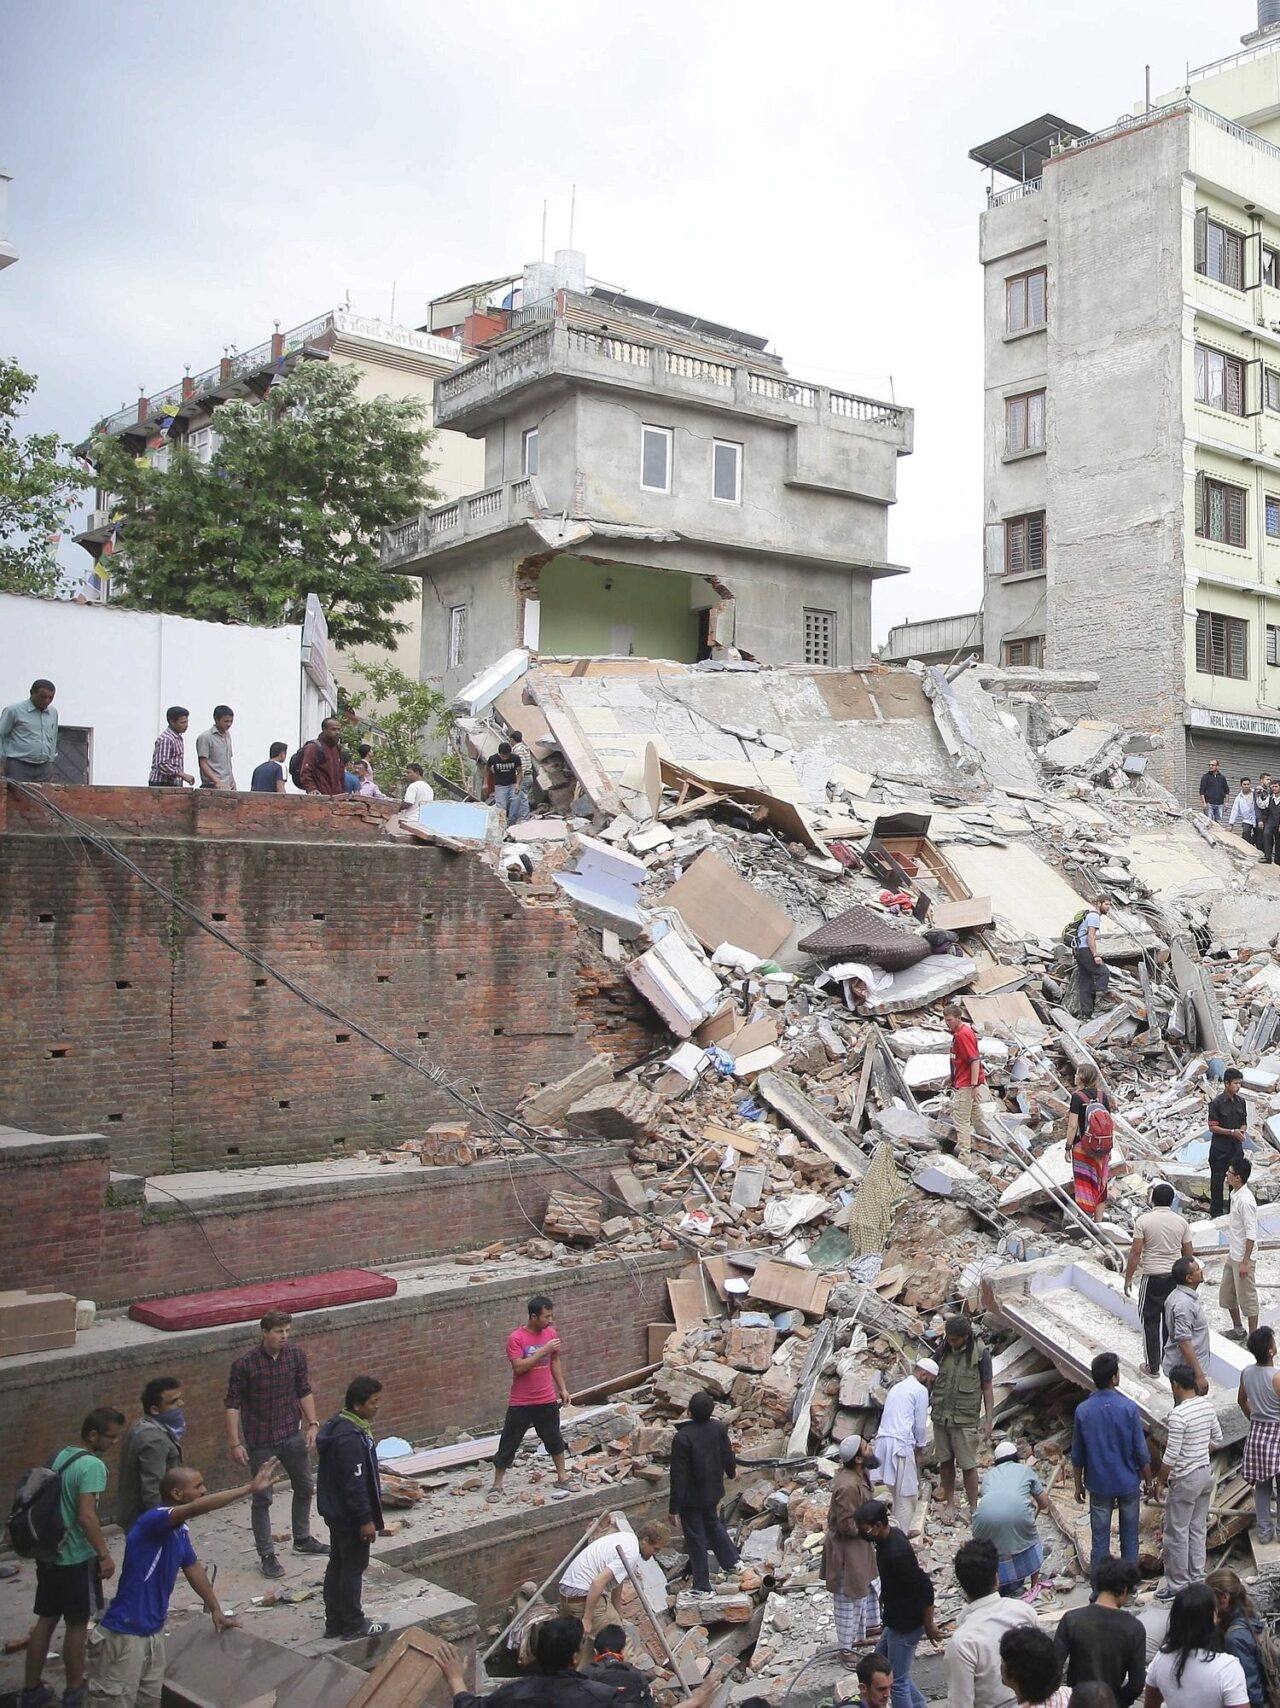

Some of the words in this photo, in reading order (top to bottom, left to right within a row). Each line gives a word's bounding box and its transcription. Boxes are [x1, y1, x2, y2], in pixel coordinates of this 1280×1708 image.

[1210, 715, 1225, 728] NEPAL
[1225, 717, 1239, 729] SOUTH
[1240, 719, 1250, 731] ASIA
[1261, 721, 1277, 735] TRAVELS
[354, 1463, 362, 1476] J
